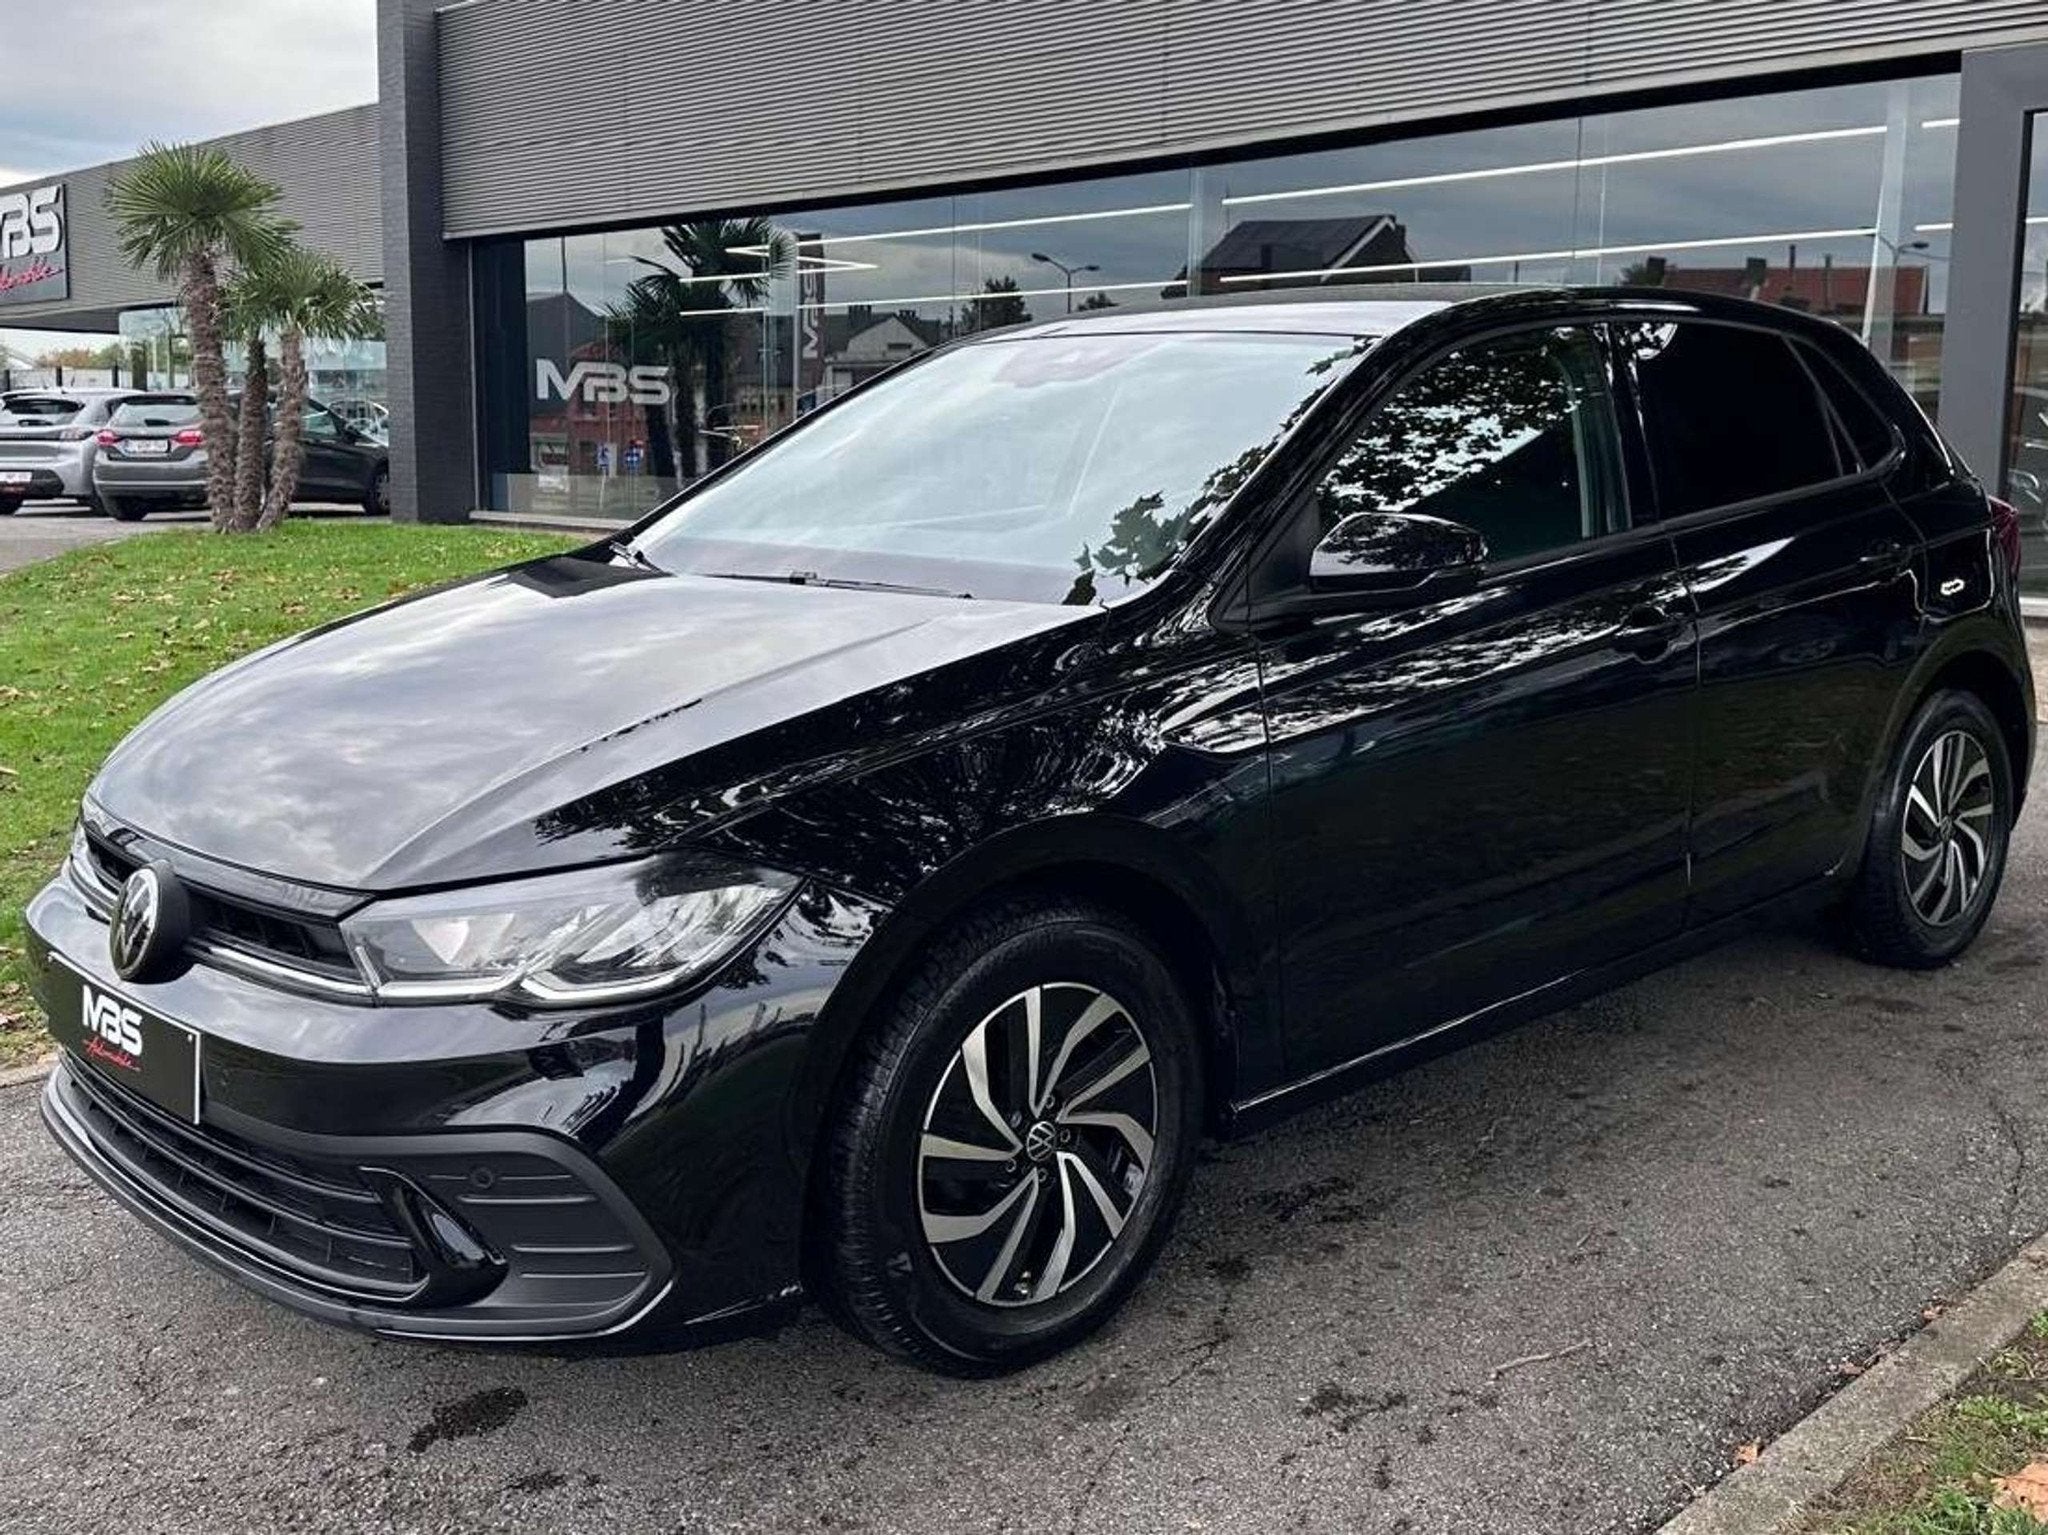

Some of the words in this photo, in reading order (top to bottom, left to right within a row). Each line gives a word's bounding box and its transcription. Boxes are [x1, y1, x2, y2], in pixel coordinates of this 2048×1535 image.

[0, 186, 60, 260] BS
[536, 358, 671, 404] MBS
[82, 984, 143, 1056] MBS
